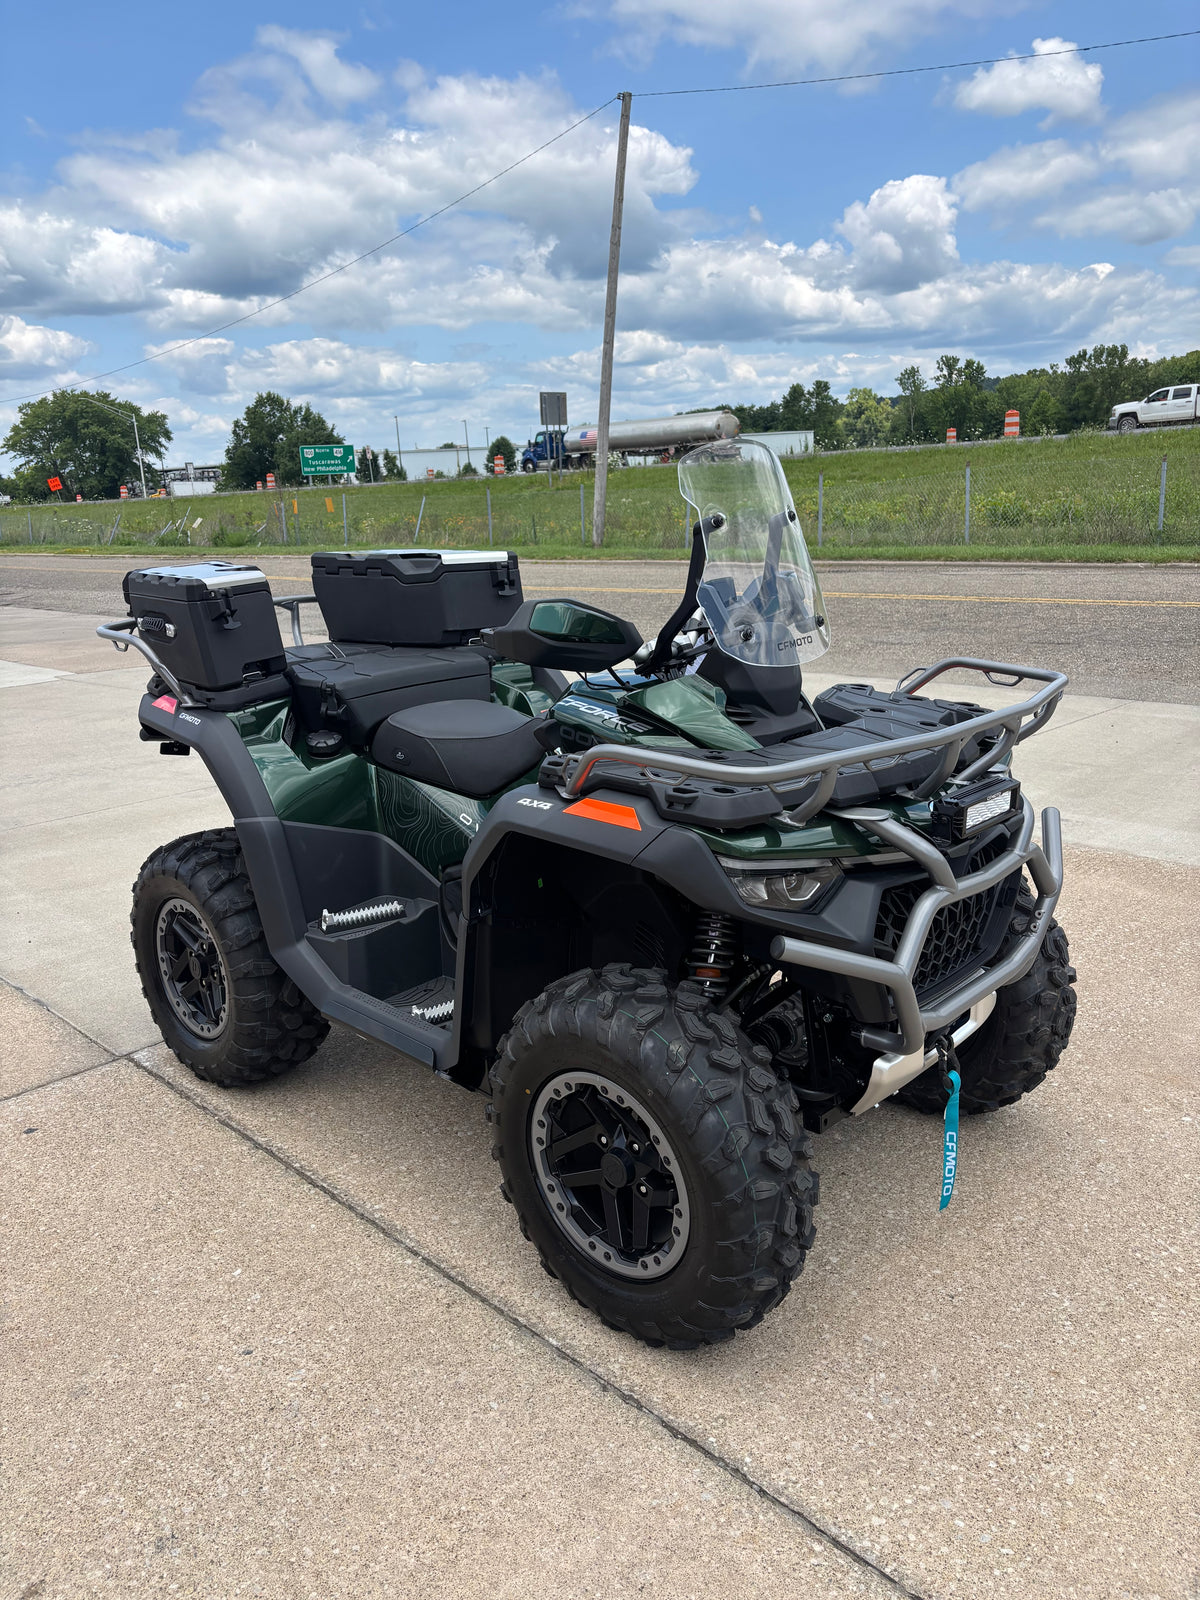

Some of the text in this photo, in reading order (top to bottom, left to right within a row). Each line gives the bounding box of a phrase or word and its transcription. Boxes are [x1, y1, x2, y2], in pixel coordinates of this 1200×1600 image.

[777, 635, 813, 651] CFMOTO
[178, 712, 202, 726] CFMOTO
[556, 698, 654, 733] CFORCE
[943, 1131, 957, 1197] CFMOTO
